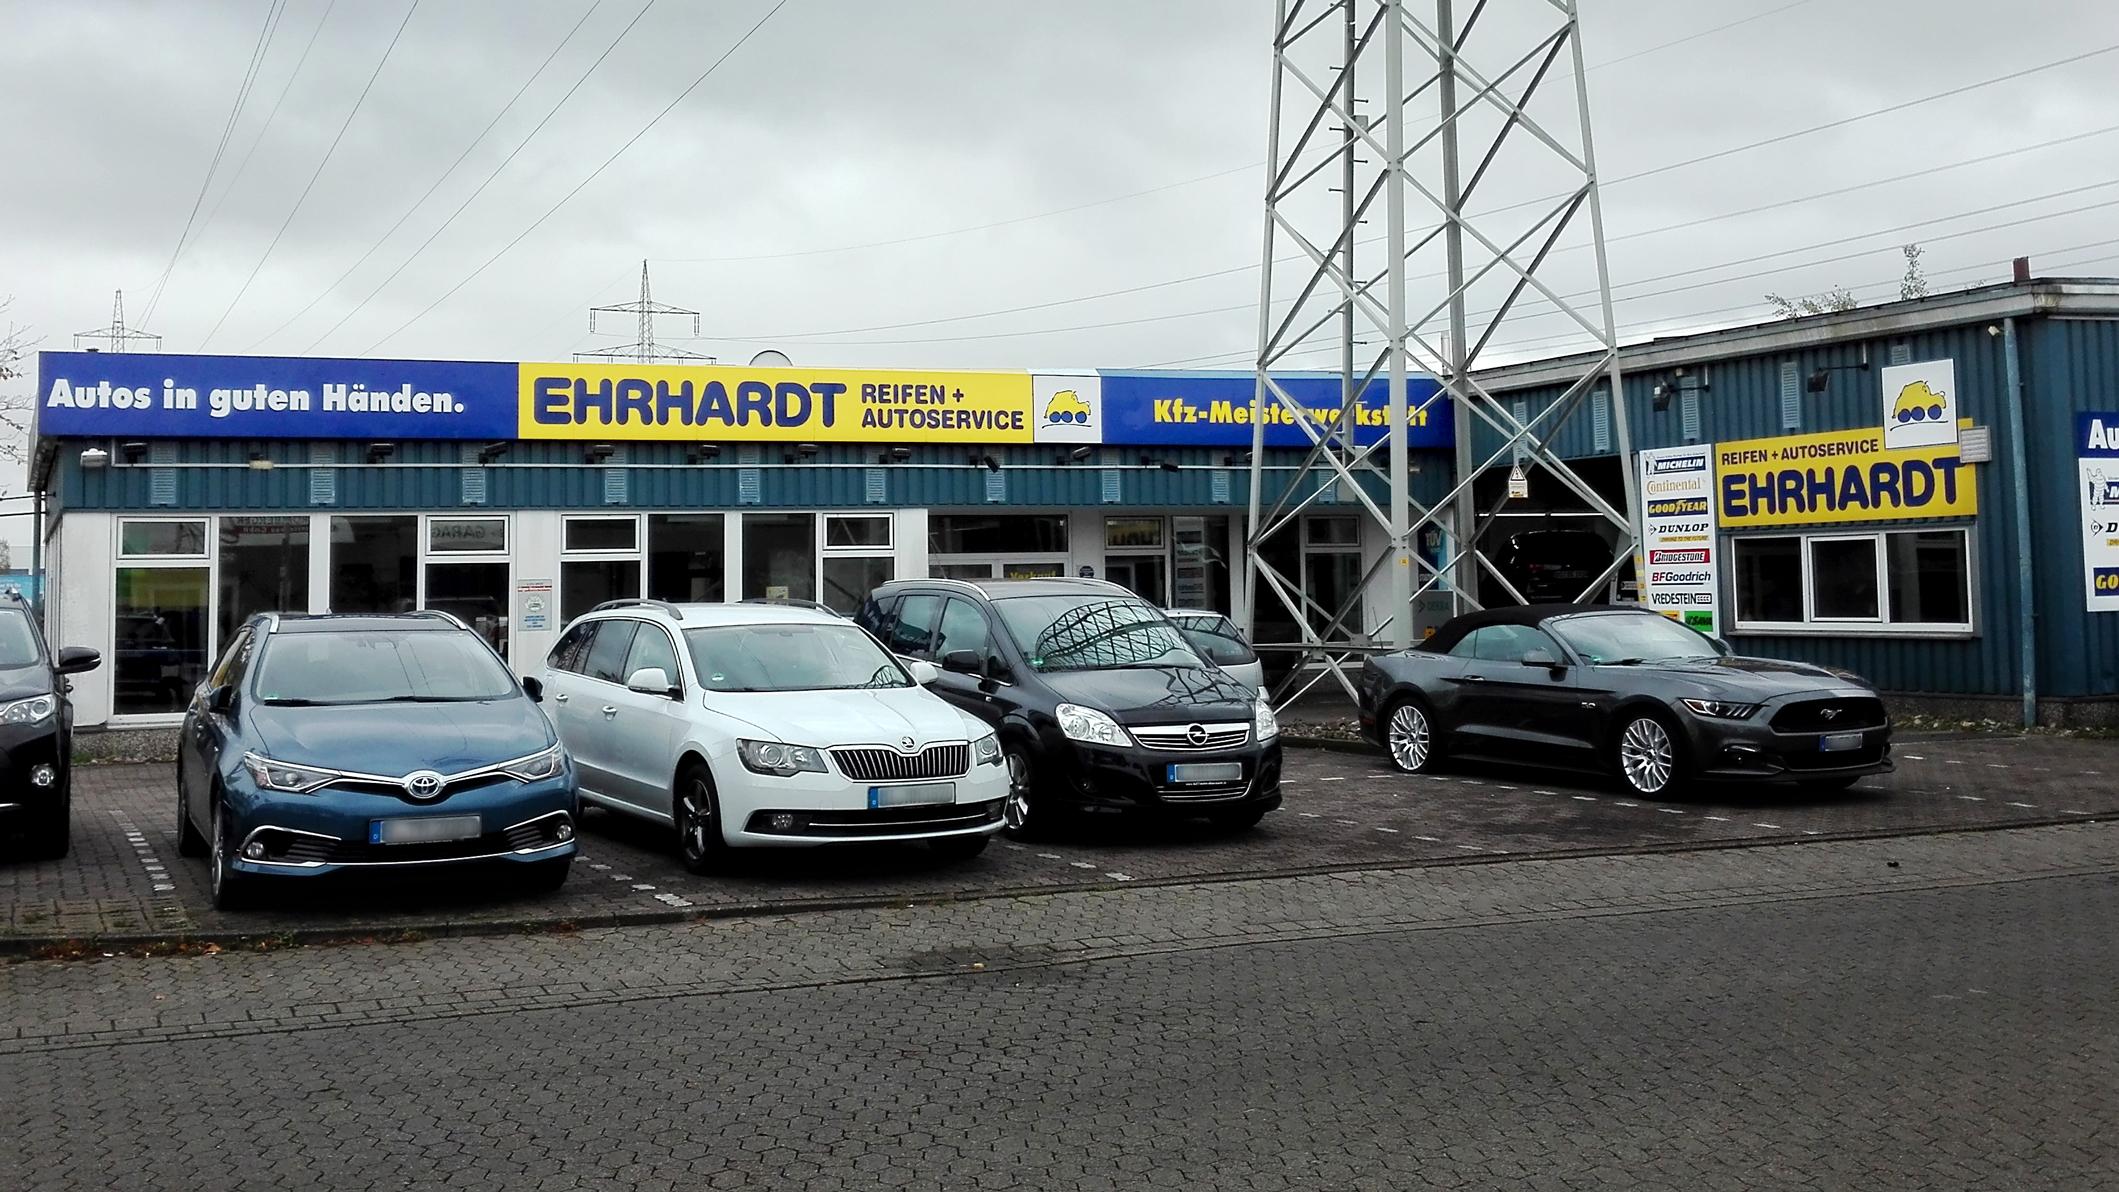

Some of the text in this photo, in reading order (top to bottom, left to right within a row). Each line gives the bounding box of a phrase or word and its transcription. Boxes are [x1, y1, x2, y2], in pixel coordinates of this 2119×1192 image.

[47, 378, 465, 418] Autos in guten Händen.
[534, 377, 847, 428] EHRHARDT
[861, 384, 964, 405] REIFEN +
[862, 408, 1024, 430] AUTOSERVICE
[1153, 398, 1427, 427] Kfz-Meisteweksttt
[1721, 448, 1768, 466] REIFEN
[1780, 438, 1879, 461] AUTOSERVICE
[1657, 458, 1704, 470] MICHELIN
[1647, 477, 1701, 495] Continental
[1722, 456, 1966, 518] EHRHARDT
[1648, 499, 1707, 515] GOODYEAR
[1658, 523, 1709, 533] DUNLOP
[1654, 551, 1704, 562] BRIDGESTONE
[1651, 571, 1711, 582] BFGoodrich
[1651, 593, 1697, 605] VREDESTEIN
